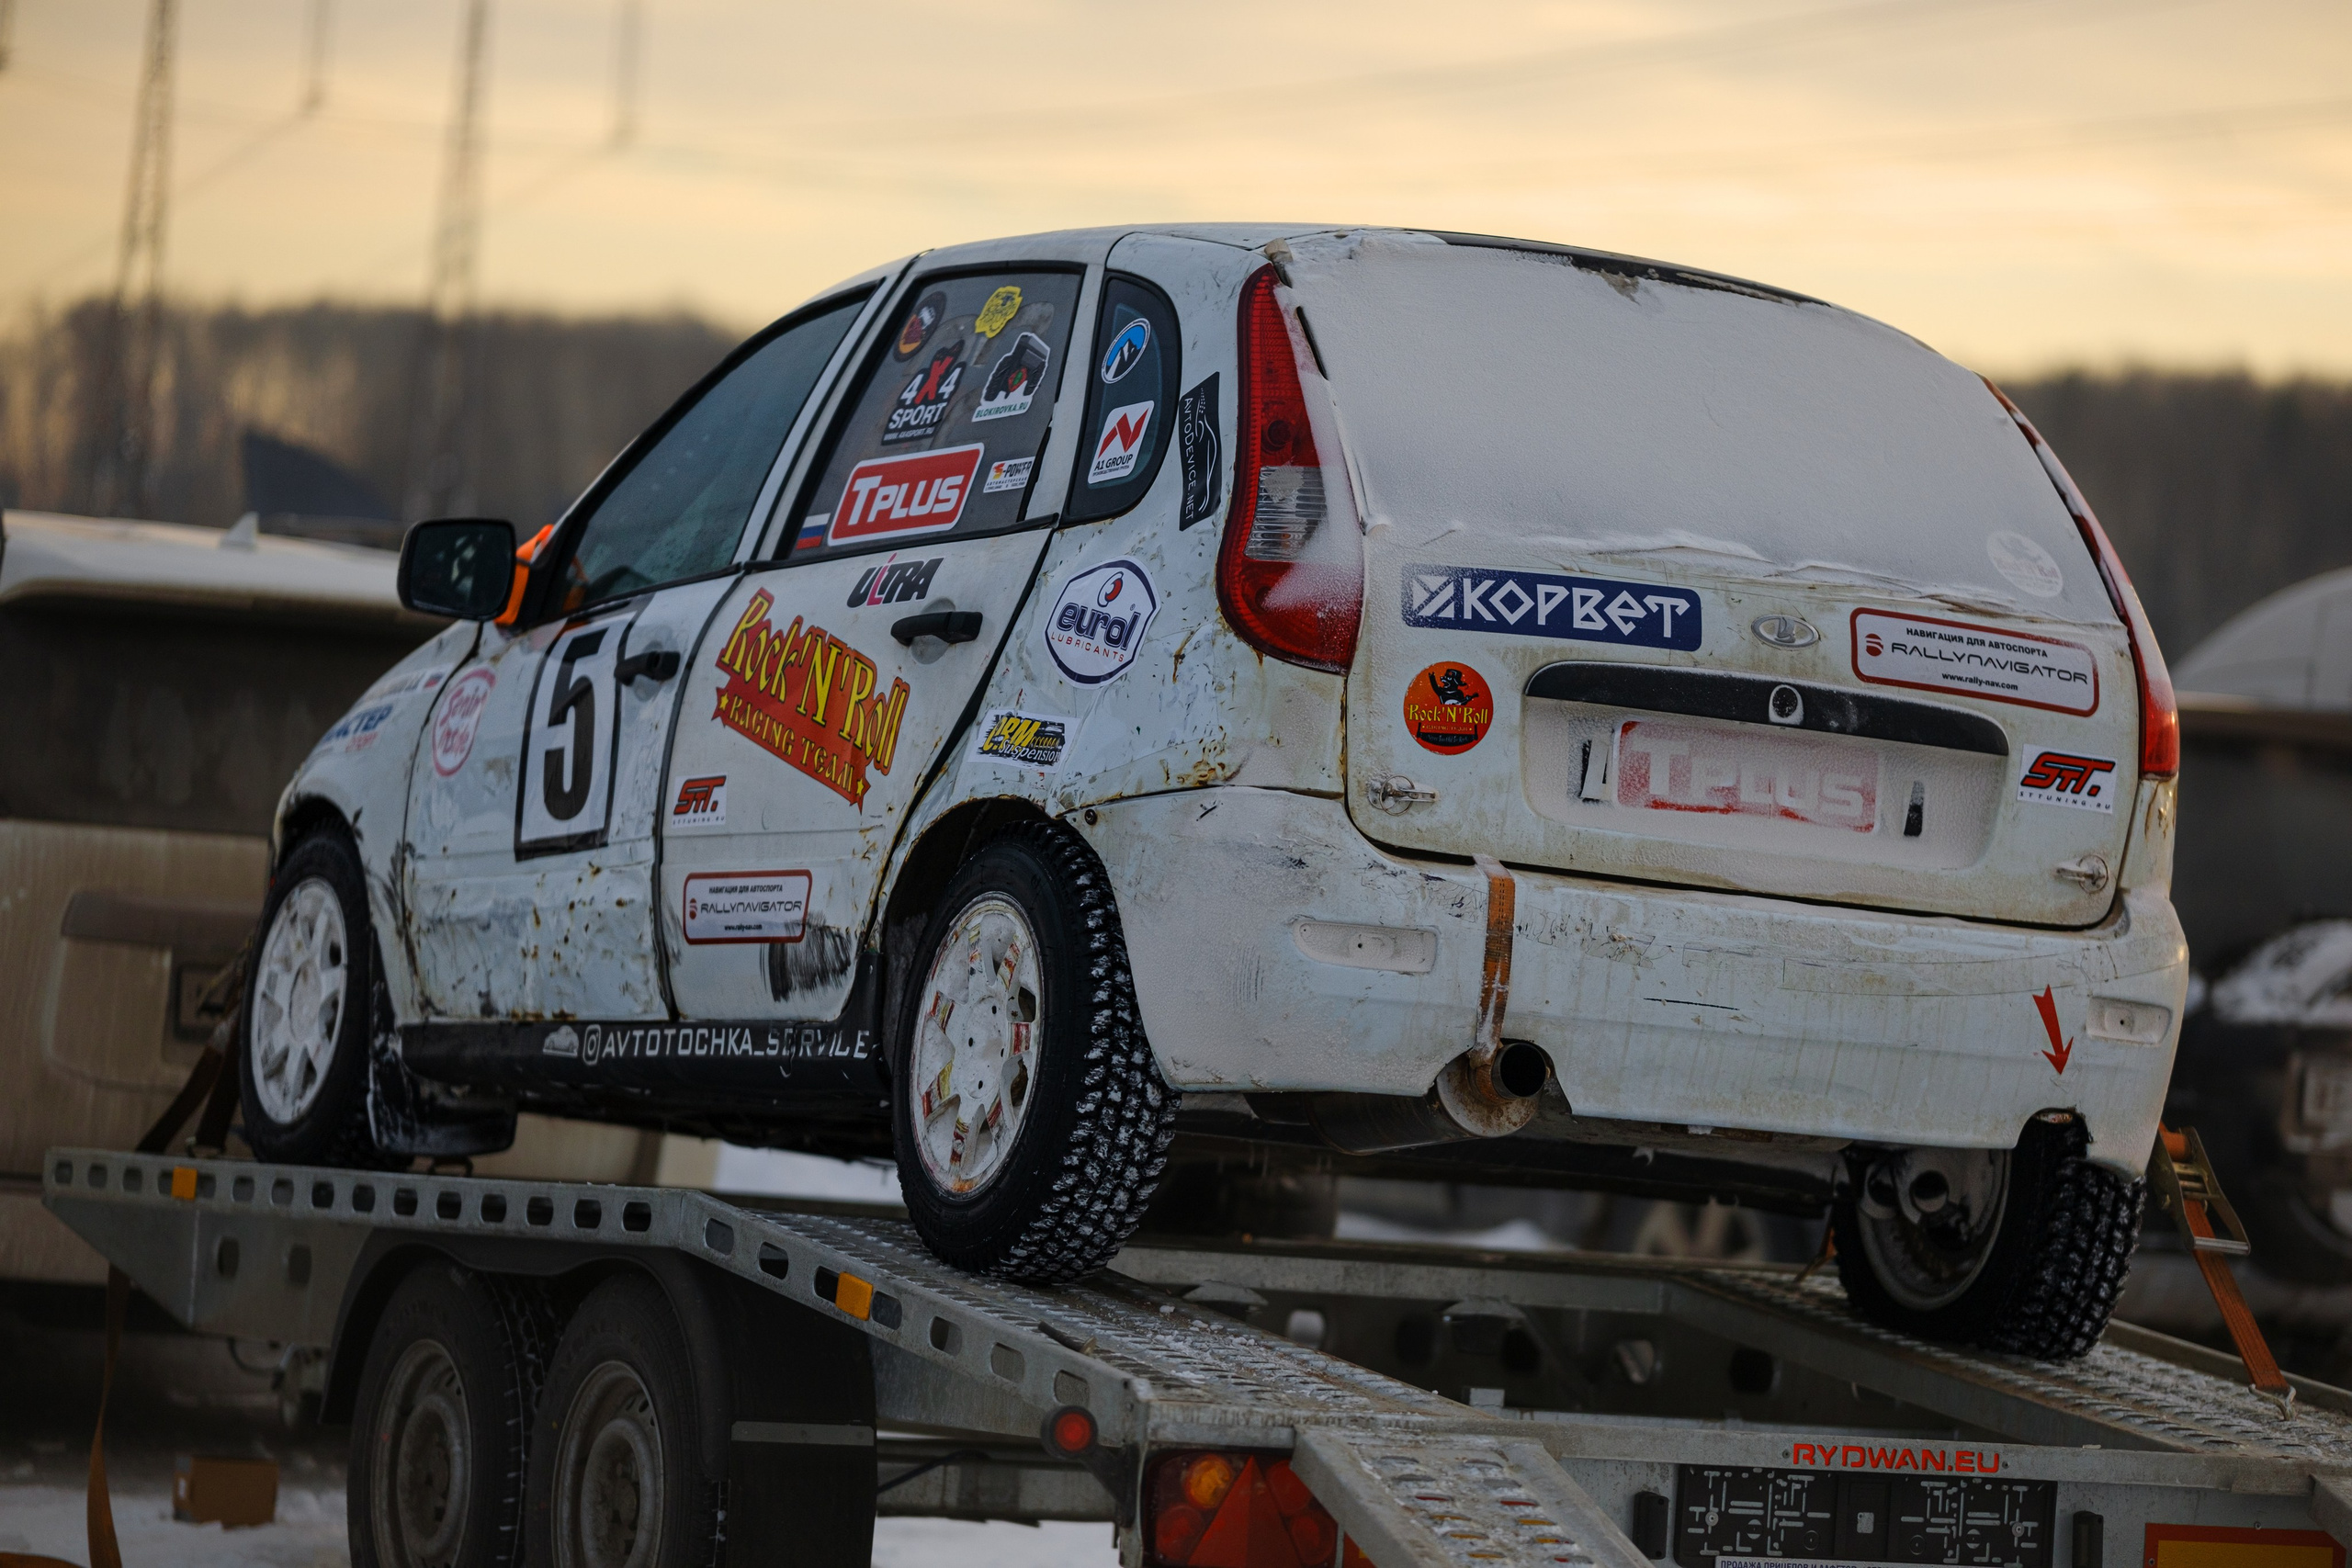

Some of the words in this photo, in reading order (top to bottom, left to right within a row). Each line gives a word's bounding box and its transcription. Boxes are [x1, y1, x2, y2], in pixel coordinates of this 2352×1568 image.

[888, 402, 948, 430] SPORT
[974, 401, 1029, 419] BLOKIROVKA.RU
[1105, 454, 1134, 469] GROUP
[847, 475, 966, 526] TPLUS
[1057, 602, 1142, 652] eurol
[1050, 631, 1125, 662] LUBRICANTS
[1905, 627, 1964, 644] НАВИГАЦИЯ
[1966, 636, 1985, 648] ДЛЯ
[1987, 639, 2048, 658] АВТОСПОРТА
[1891, 642, 2088, 684] RALLYNAVIGATOR
[1941, 671, 2018, 691] www.rally-nav.com
[543, 626, 610, 821] 5
[729, 694, 796, 757] RACING
[999, 739, 1062, 762] Suspension
[2018, 790, 2111, 810] STTUNING.RU
[709, 885, 739, 895] НАВИГАЦИЯ
[750, 884, 783, 893] АВТОСПОРТА
[700, 900, 803, 914] RALLYNAVIGATOR
[1792, 1443, 2000, 1473] RYDWAN.EU
